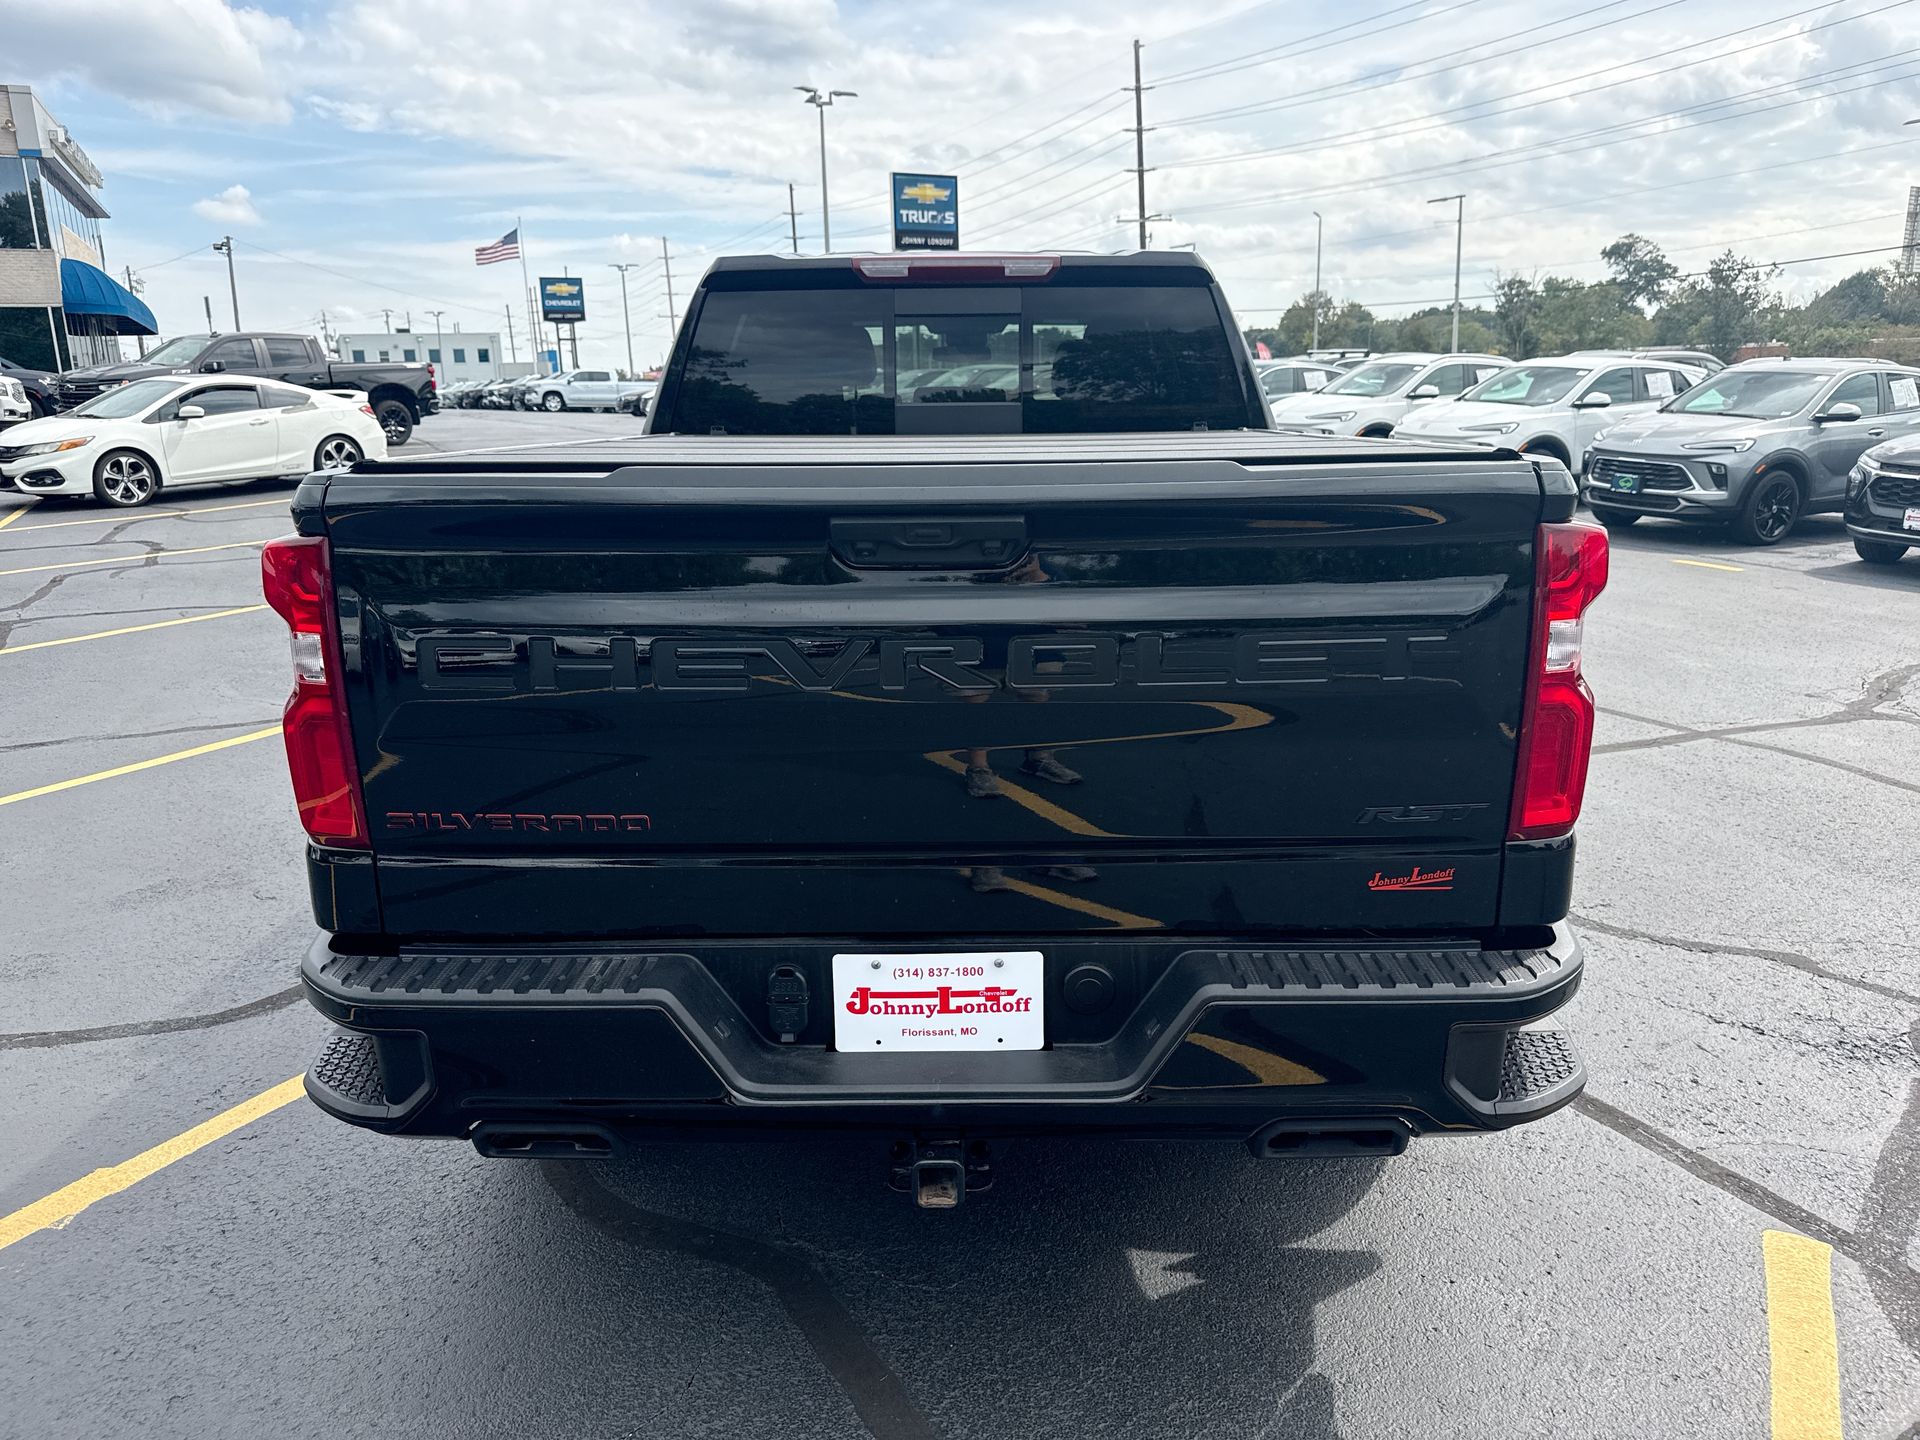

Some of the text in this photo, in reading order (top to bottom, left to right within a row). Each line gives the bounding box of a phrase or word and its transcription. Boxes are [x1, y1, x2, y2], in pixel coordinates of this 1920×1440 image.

[901, 236, 925, 245] JOHNNY
[416, 629, 1460, 690] CHEVROLET
[1352, 802, 1491, 824] RST
[386, 812, 651, 832] SILVERADO
[893, 966, 984, 980] (314) 837-1800
[901, 1027, 978, 1037] Florissant, MO
